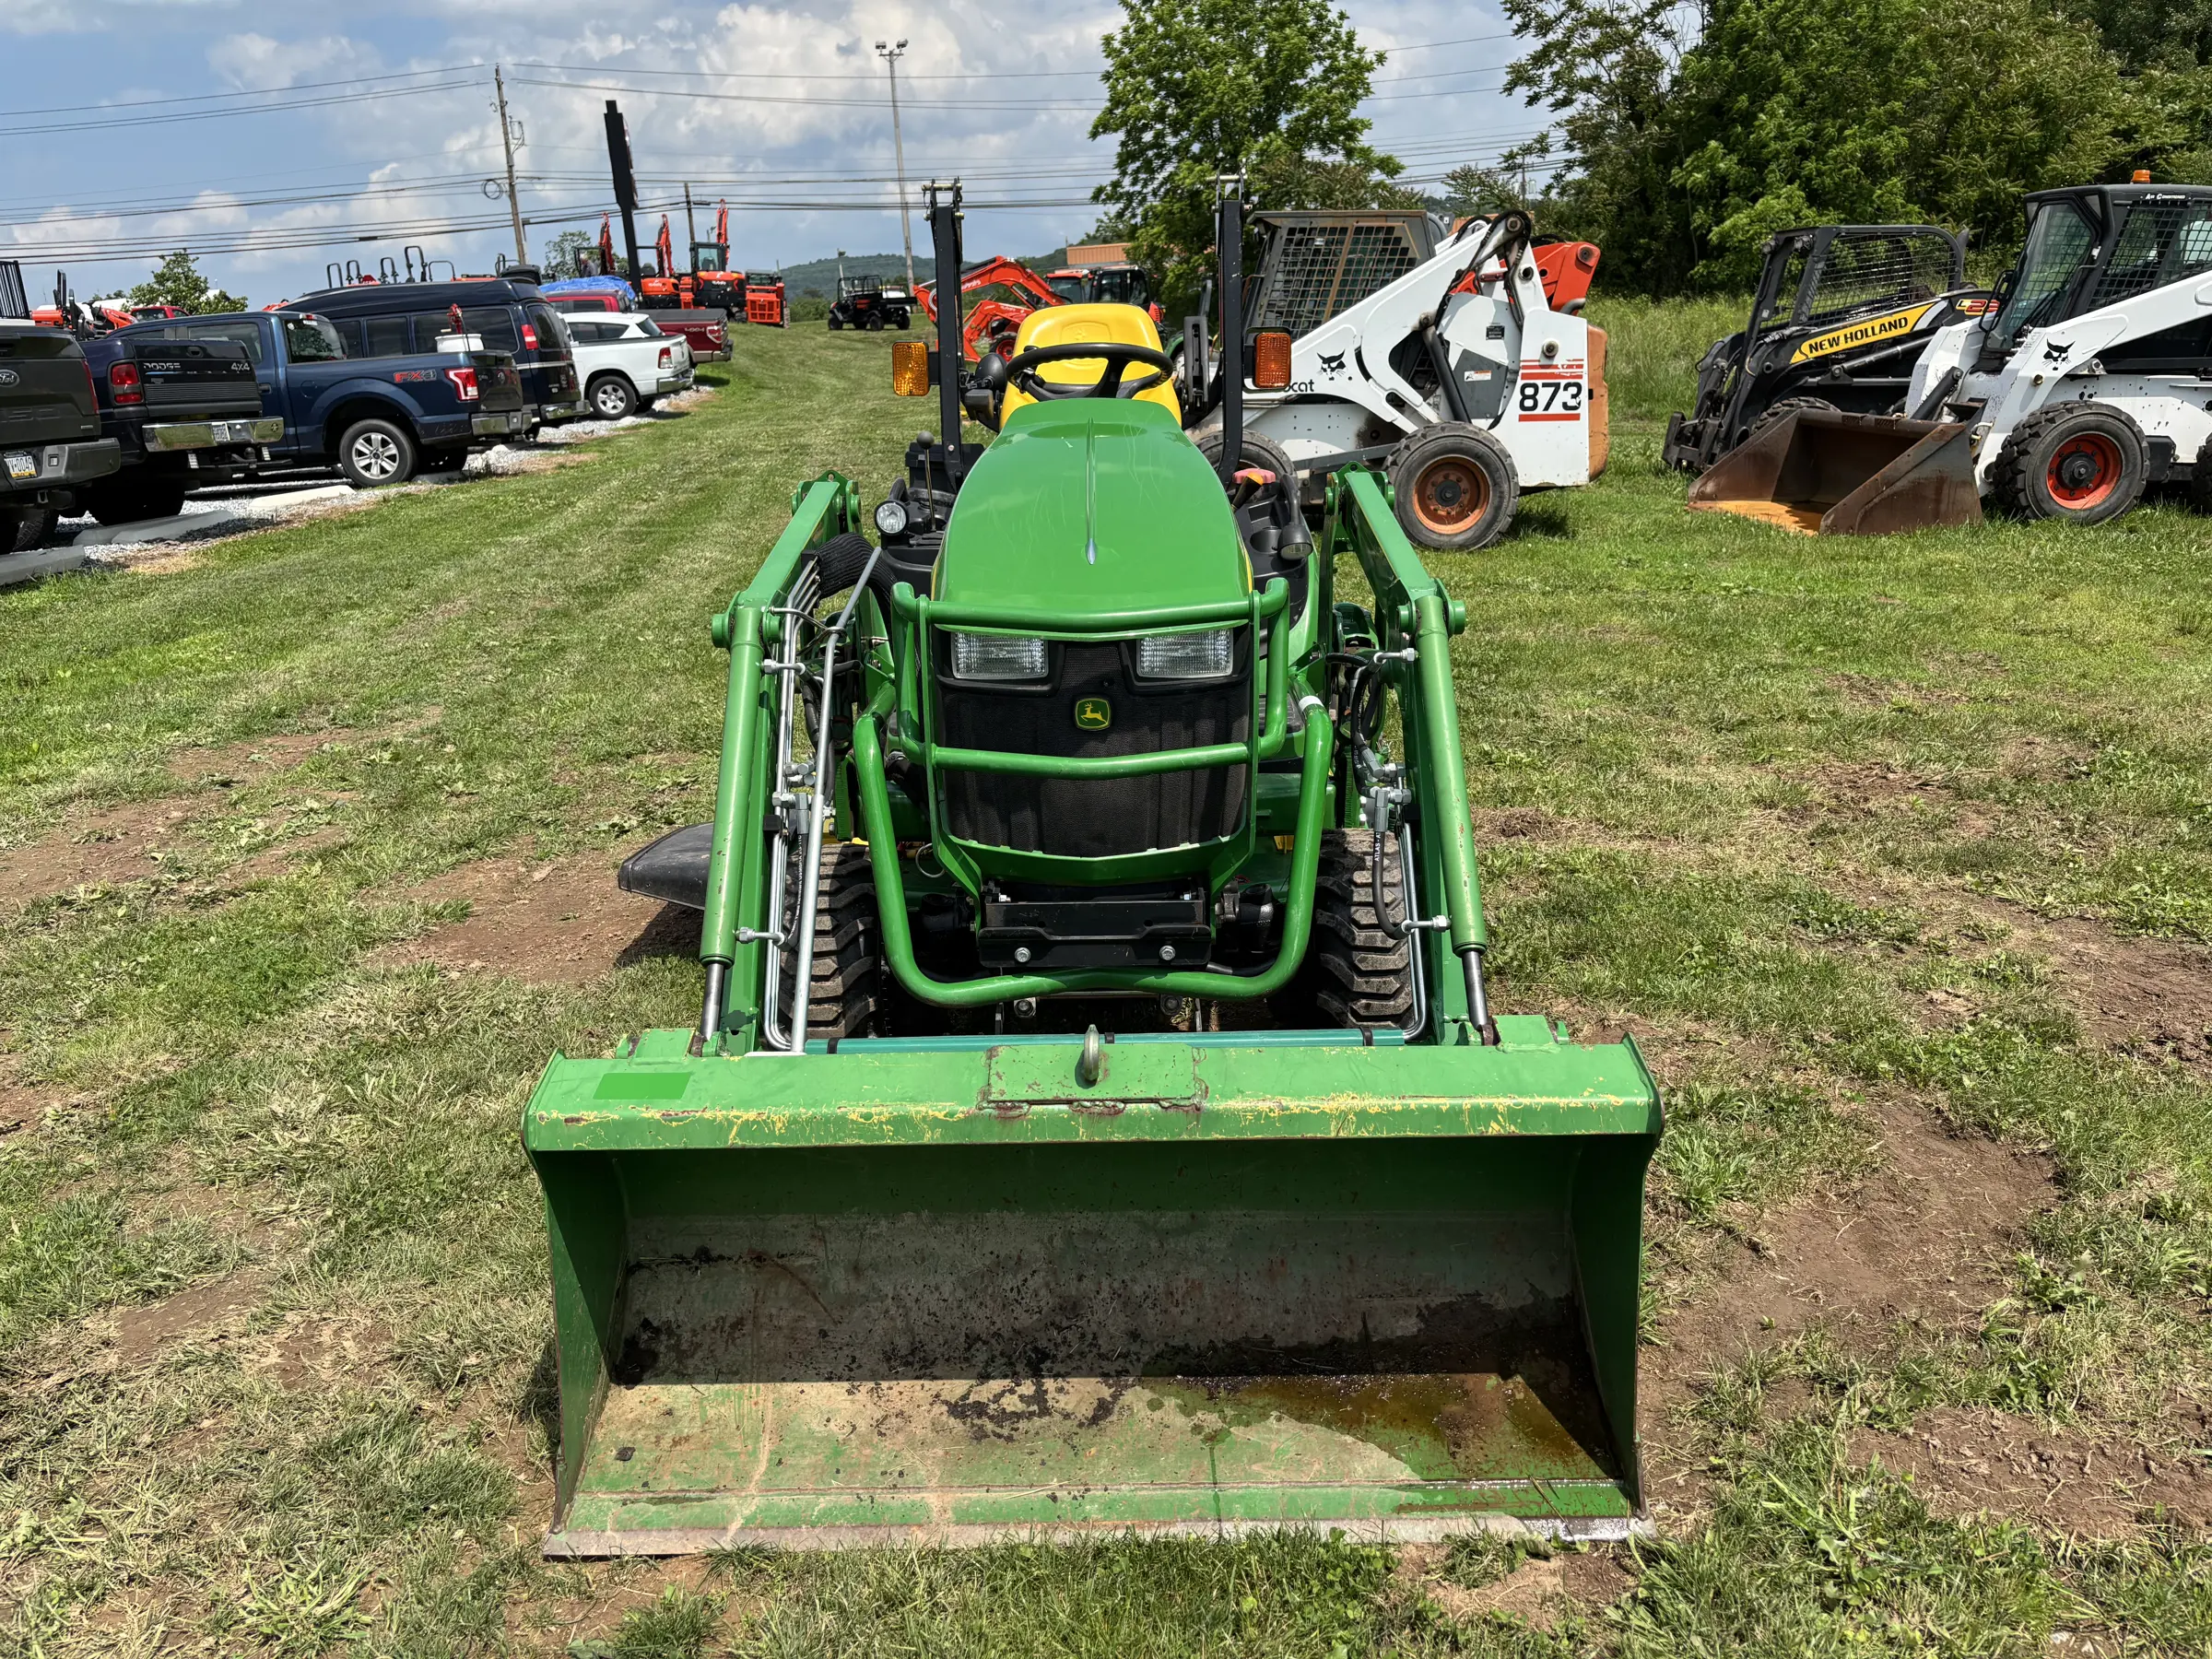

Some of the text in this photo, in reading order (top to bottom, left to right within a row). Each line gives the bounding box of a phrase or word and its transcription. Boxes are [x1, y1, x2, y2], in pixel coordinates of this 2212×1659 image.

[1808, 316, 1909, 355] NEW HOLLAND
[143, 362, 182, 371] DODGE
[394, 369, 437, 383] FX4
[1519, 382, 1583, 412] 873
[1373, 842, 1382, 862] ATLAS
